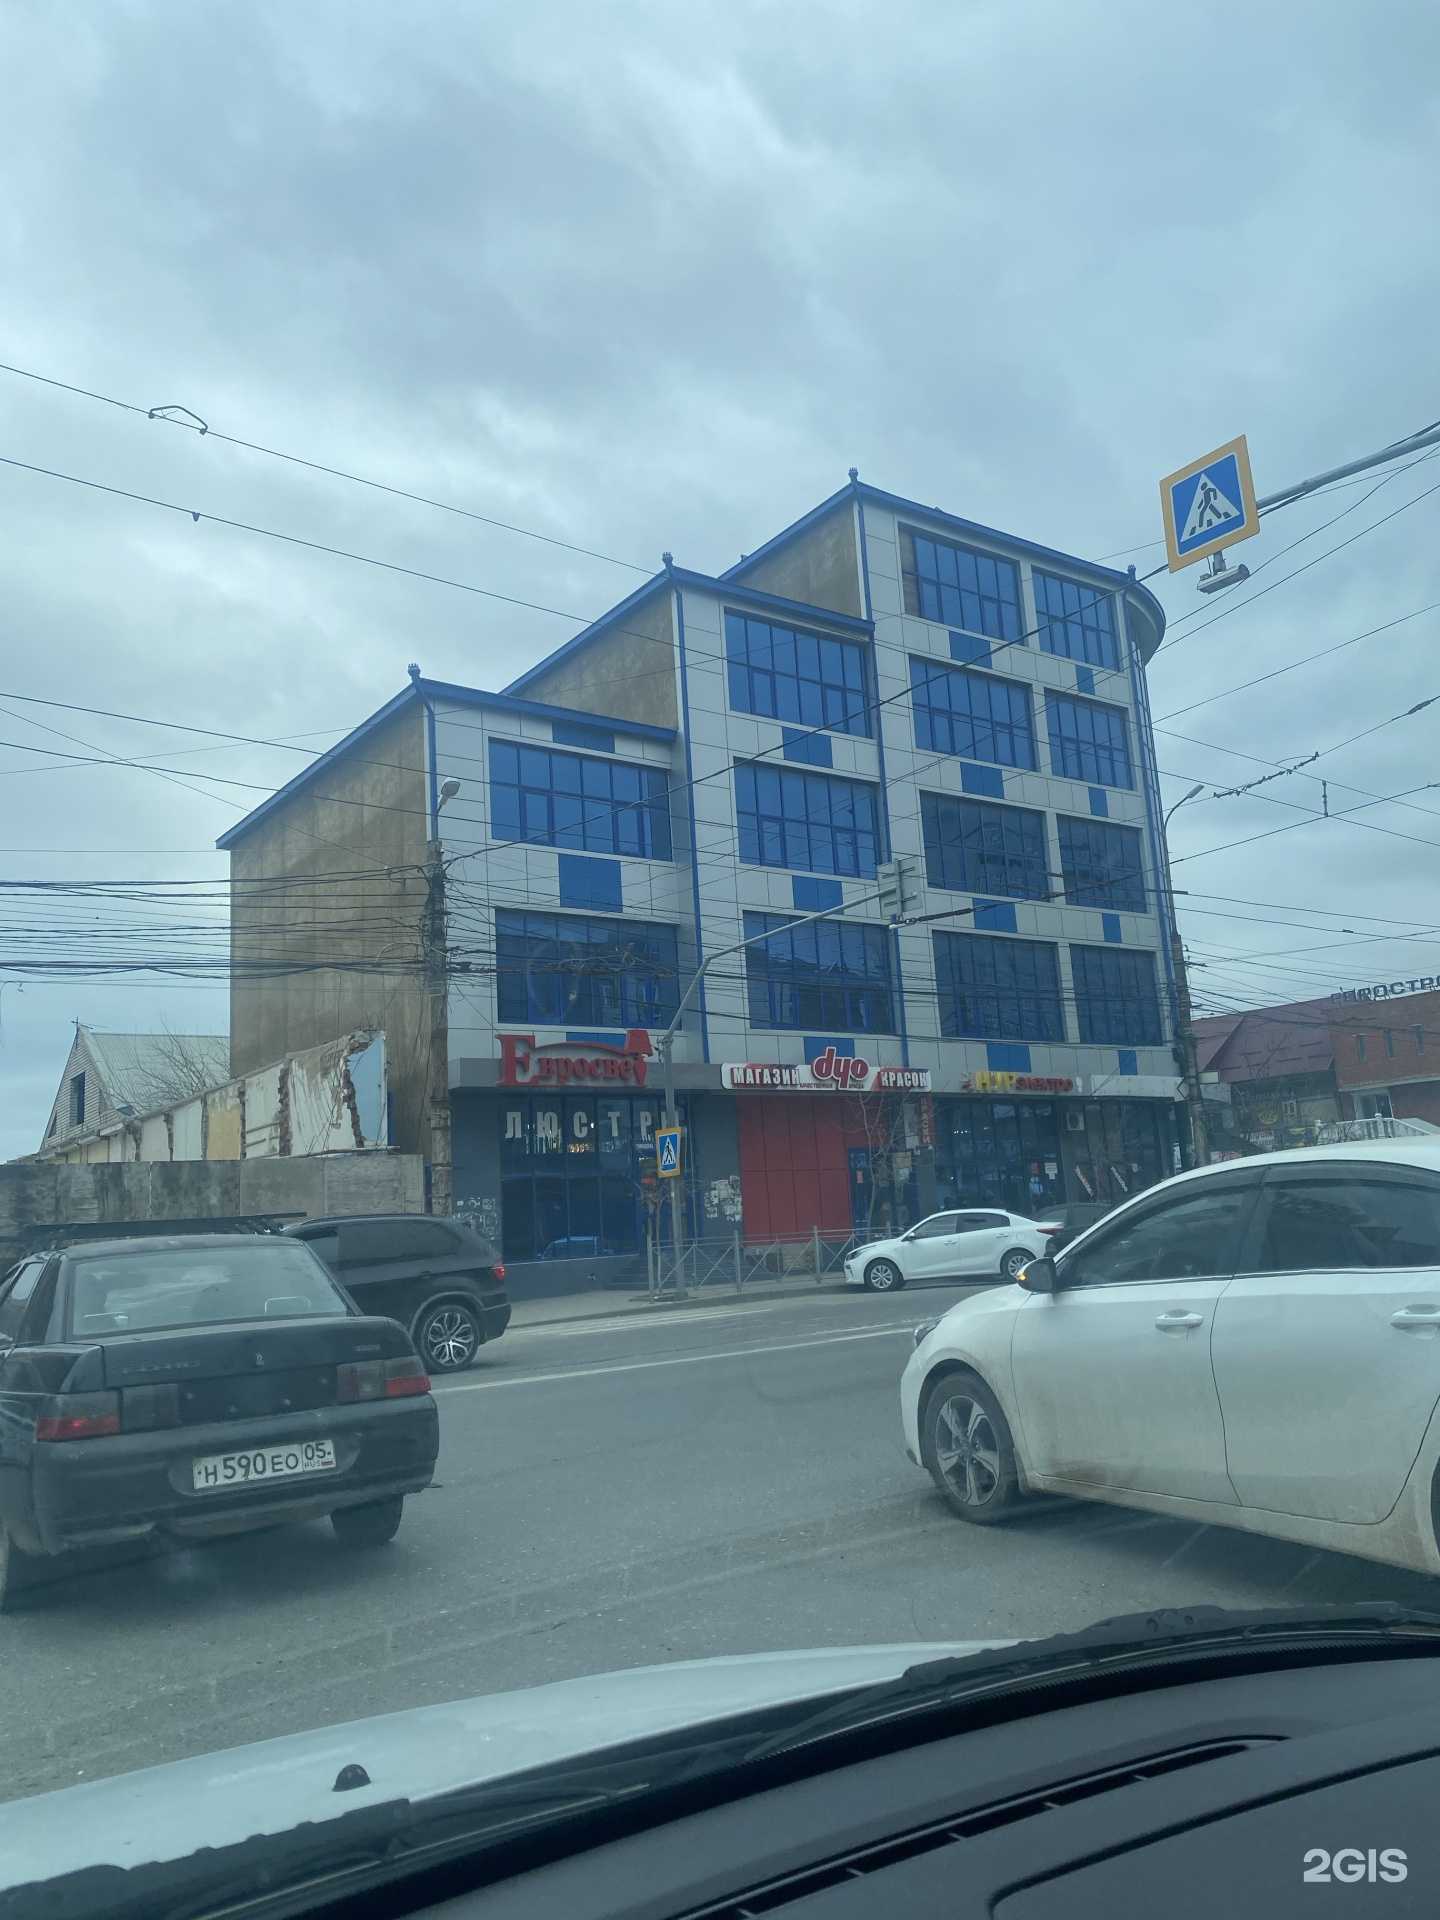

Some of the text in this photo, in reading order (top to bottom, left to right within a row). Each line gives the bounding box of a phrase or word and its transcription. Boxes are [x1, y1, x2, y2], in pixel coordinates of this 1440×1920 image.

[732, 1066, 801, 1086] МАГАЗИН
[811, 1046, 869, 1090] dyo
[304, 1442, 326, 1461] 05
